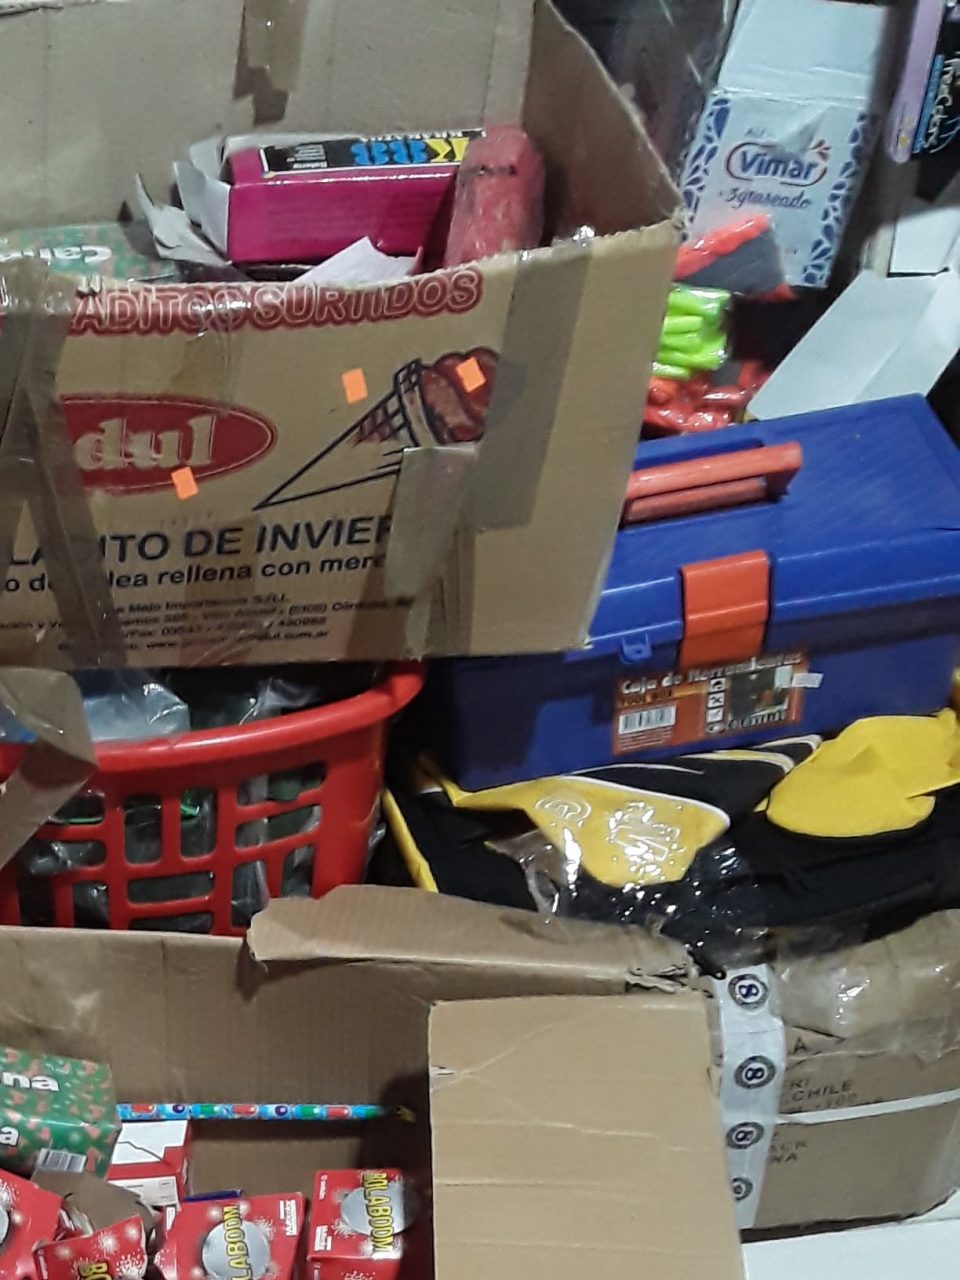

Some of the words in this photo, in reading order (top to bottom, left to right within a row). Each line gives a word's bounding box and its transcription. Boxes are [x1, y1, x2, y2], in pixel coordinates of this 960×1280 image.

[740, 151, 818, 180] Vimar
[183, 527, 245, 558] DE
[157, 562, 252, 586] rellena
[261, 560, 310, 577] con
[621, 680, 657, 694] Caja
[661, 673, 683, 687] de
